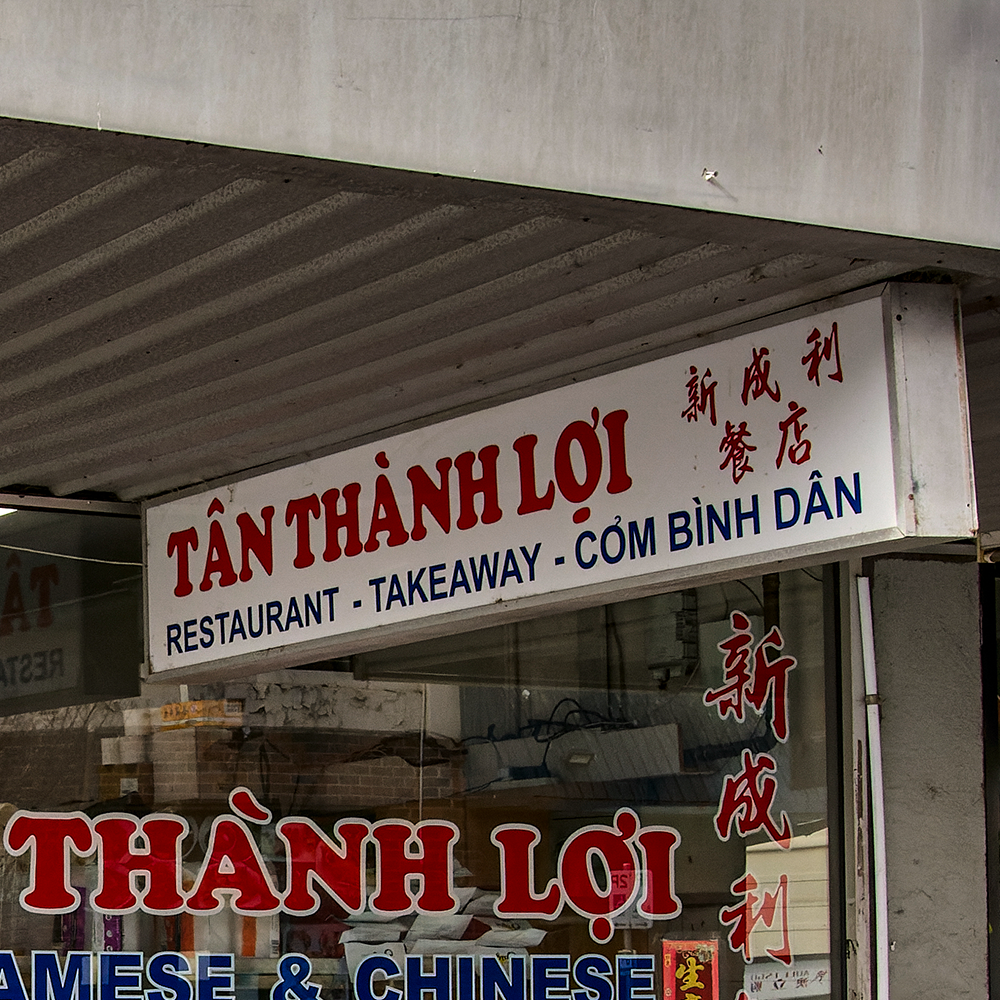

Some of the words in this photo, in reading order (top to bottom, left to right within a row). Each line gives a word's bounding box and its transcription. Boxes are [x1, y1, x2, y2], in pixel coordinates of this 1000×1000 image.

[680, 321, 843, 426] 新成利
[719, 401, 813, 482] 餐店
[166, 586, 339, 656] RESTAURANT
[373, 542, 542, 611] TAKEAWAY
[669, 495, 760, 552] BÌNH
[775, 470, 862, 530] DÂN
[167, 498, 276, 597] TÂN
[285, 451, 504, 558] THÀNH
[515, 407, 632, 524] LỢI
[3, 786, 460, 917] THÀNH
[490, 807, 682, 944] LỢI
